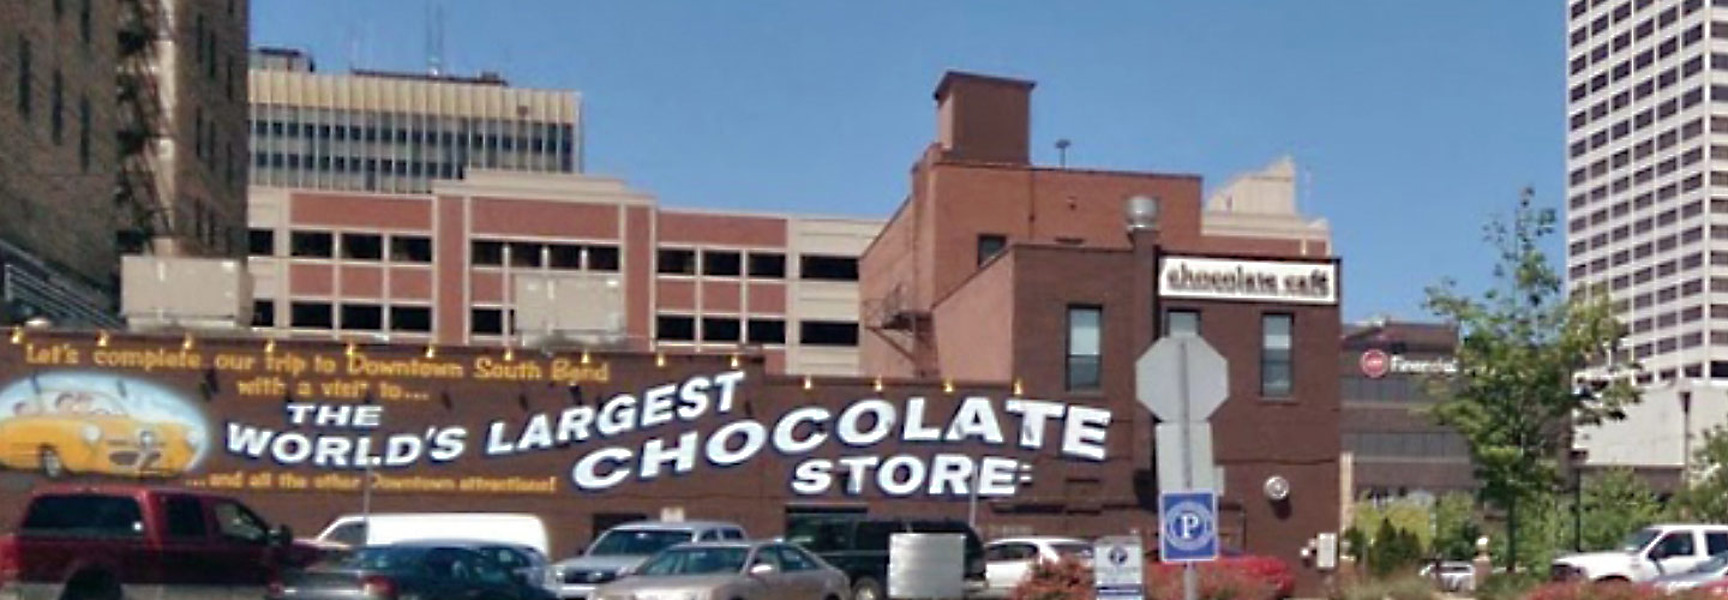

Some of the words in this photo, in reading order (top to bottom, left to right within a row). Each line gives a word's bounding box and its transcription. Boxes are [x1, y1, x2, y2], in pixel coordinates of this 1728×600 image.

[26, 343, 78, 365] Let's
[92, 348, 200, 371] complete
[214, 356, 255, 370] our
[266, 352, 306, 374] trip
[315, 356, 336, 373] to
[347, 355, 464, 378] Downtown
[474, 356, 543, 379] South
[552, 358, 609, 382] Bend
[238, 377, 286, 396] with
[297, 382, 312, 396] a
[321, 381, 368, 398] visit
[226, 423, 469, 466] WORLD'S
[487, 370, 745, 455] LARGEST
[287, 404, 383, 426] THE
[572, 396, 1112, 491] CHOCOLATE
[791, 453, 1019, 495] STORE
[1182, 515, 1199, 539] P
